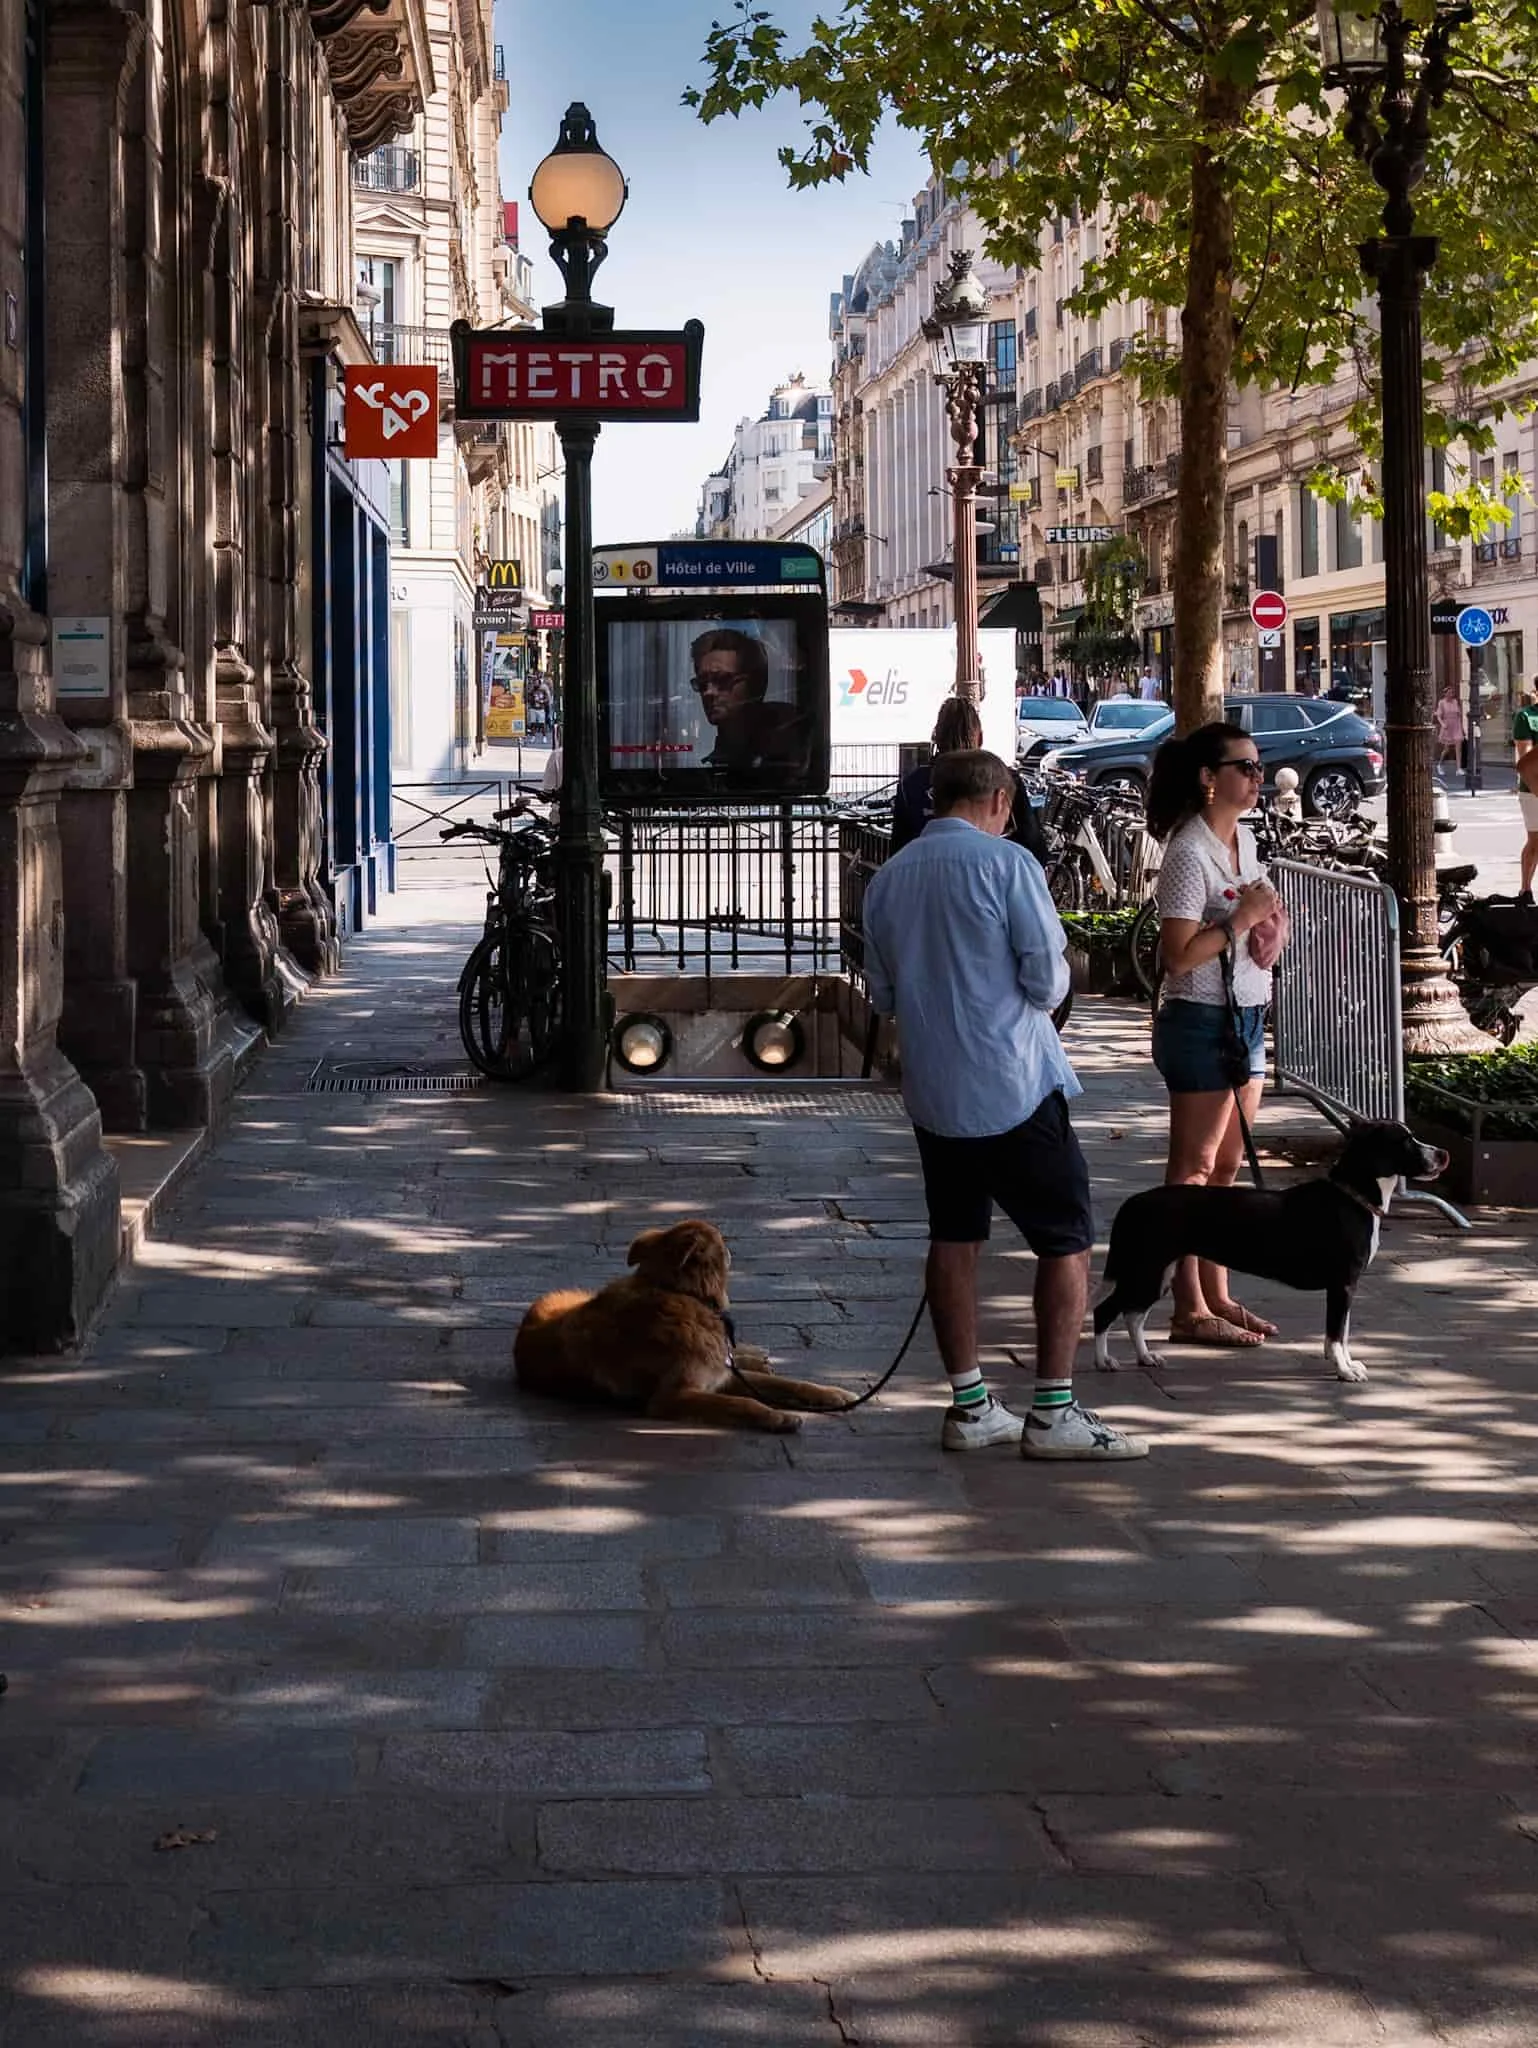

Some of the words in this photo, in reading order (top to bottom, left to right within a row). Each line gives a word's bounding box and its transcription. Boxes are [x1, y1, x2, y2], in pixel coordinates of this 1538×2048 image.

[482, 353, 672, 398] METRO
[1045, 527, 1112, 543] FLEURS
[636, 563, 650, 577] 11
[665, 561, 702, 575] Hôtel
[705, 561, 722, 574] de
[726, 561, 756, 574] Ville
[866, 668, 909, 705] elis
